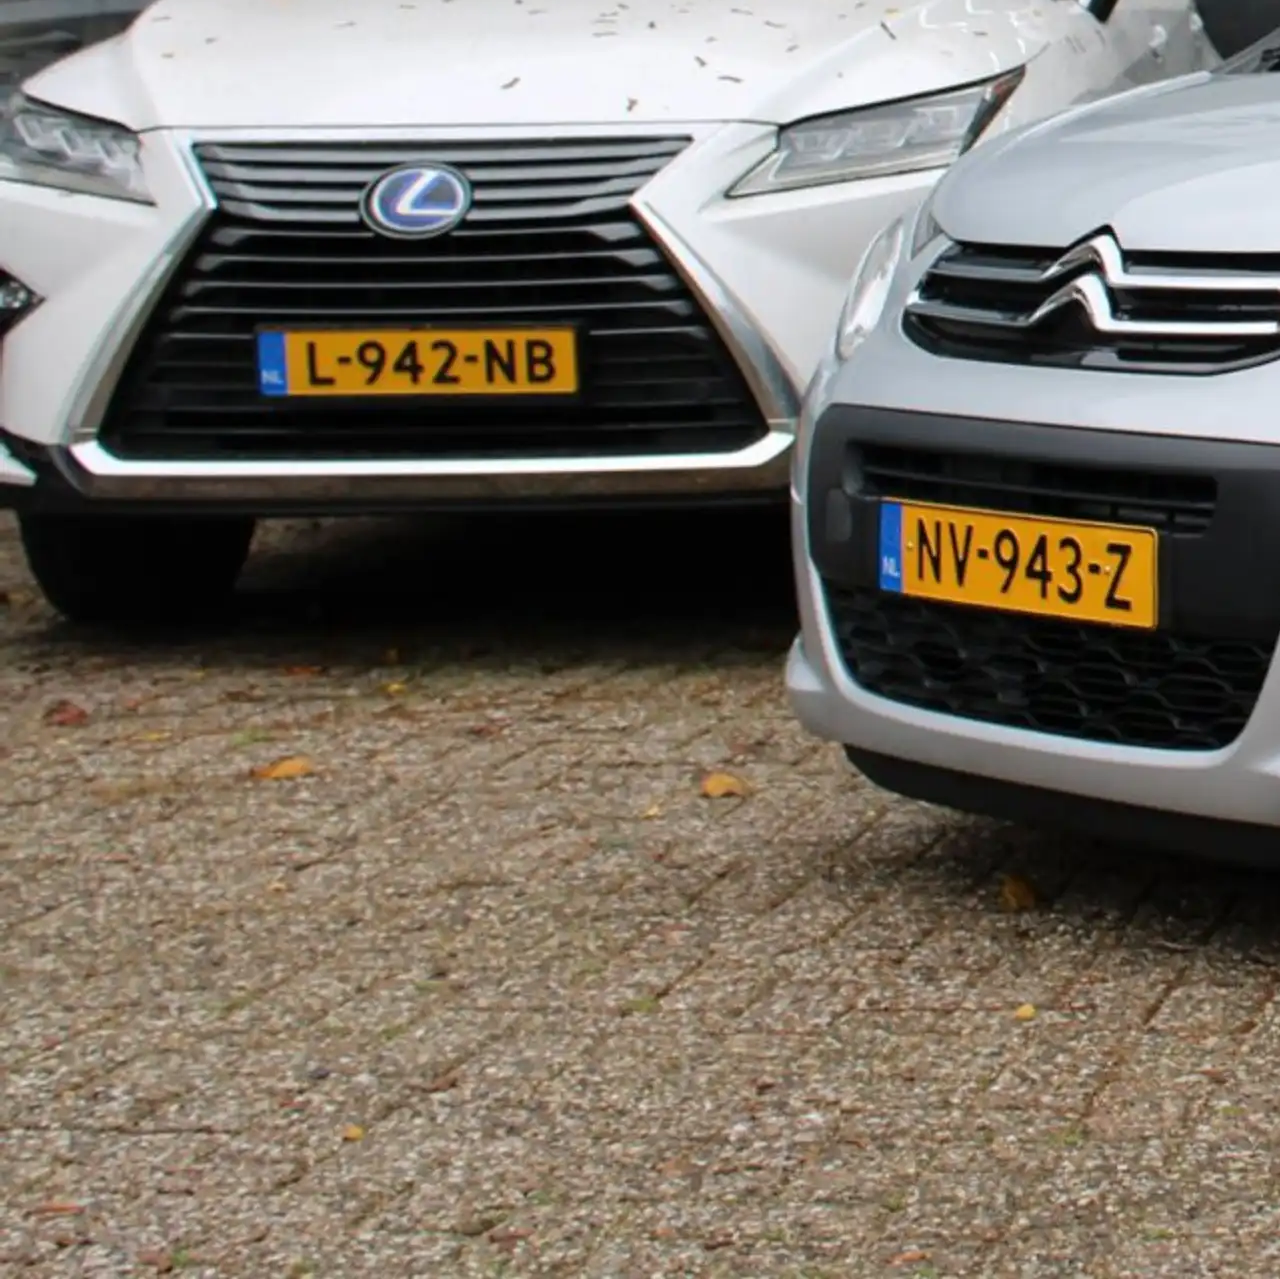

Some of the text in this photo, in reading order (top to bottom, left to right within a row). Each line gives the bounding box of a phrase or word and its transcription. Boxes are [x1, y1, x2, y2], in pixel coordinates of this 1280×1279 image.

[261, 339, 556, 387] NL L-942-NB
[882, 517, 1133, 612] NL NV-943-Z
